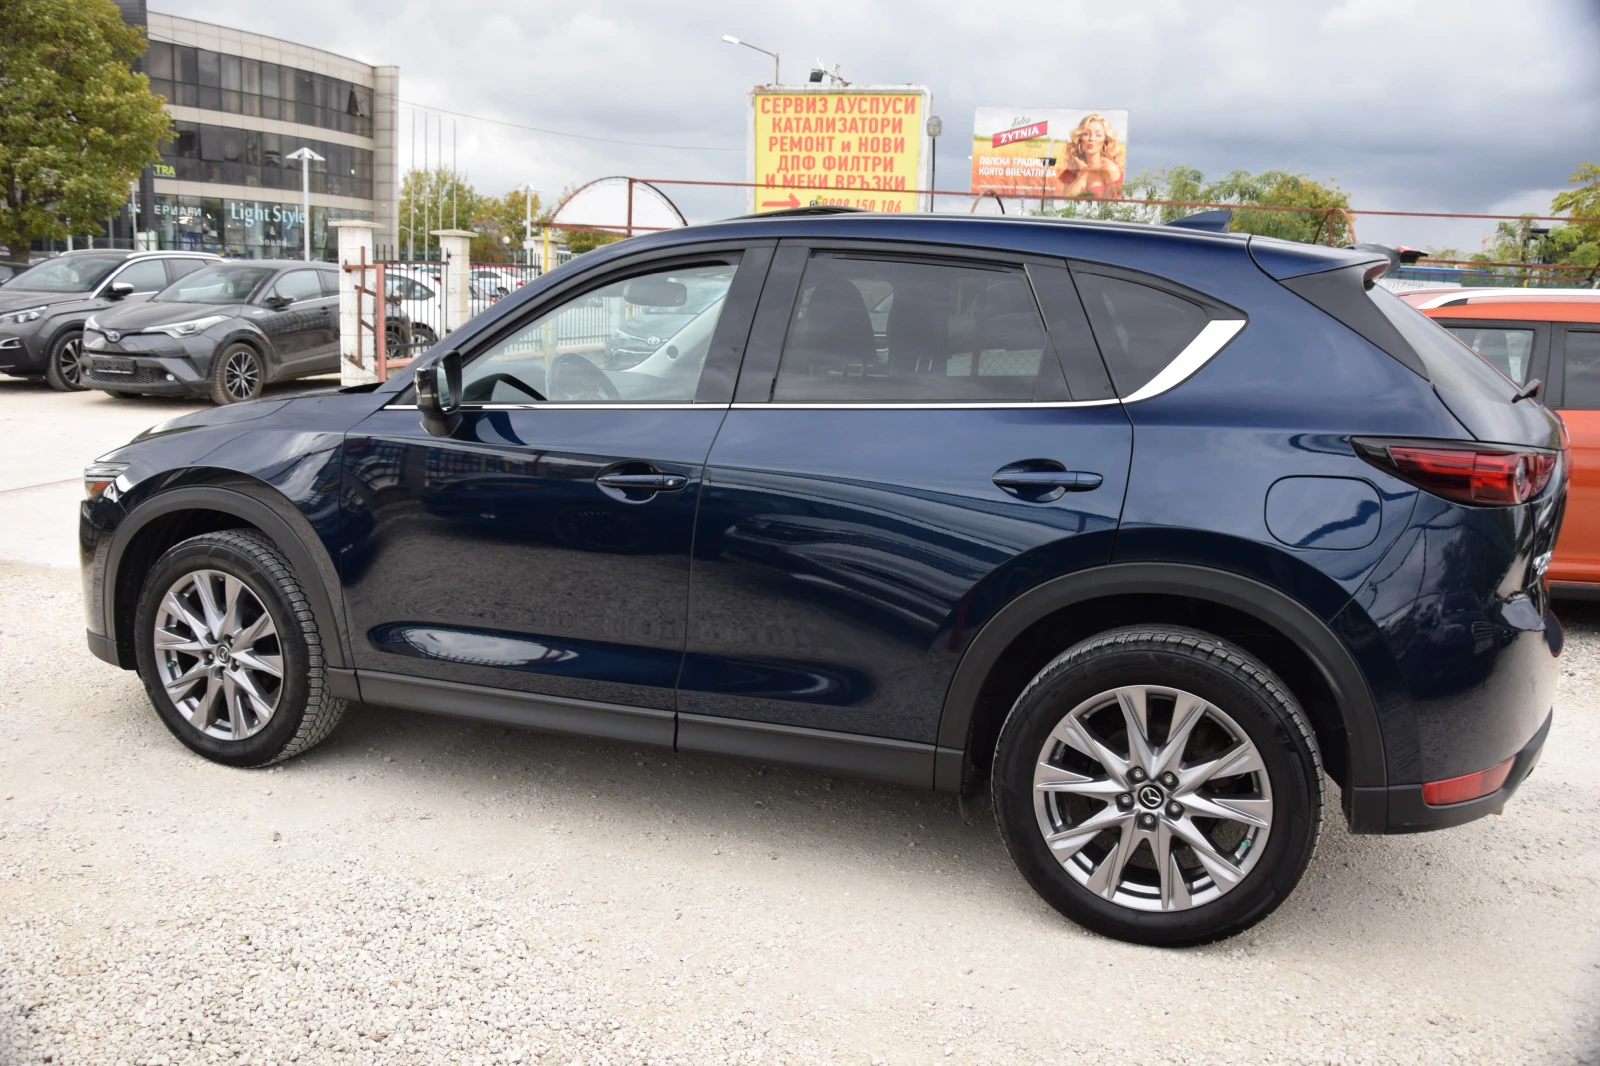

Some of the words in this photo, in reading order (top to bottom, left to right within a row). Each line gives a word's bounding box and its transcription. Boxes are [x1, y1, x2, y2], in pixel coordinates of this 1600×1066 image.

[761, 97, 828, 115] СЕРВИЗ
[835, 97, 916, 115] АУСПУСИ
[772, 117, 903, 134] КАТАЛИЗАТОРИ
[768, 136, 836, 152] РЕМОНТ
[841, 140, 851, 152] и
[858, 137, 905, 153] НОВИ
[776, 155, 816, 173] ДПФ
[822, 155, 894, 172] ФИЛТРИ
[979, 156, 1010, 165] ПОЛСКА
[153, 164, 176, 175] TRA
[978, 167, 1004, 176] КОЯТО
[765, 173, 776, 189] И
[782, 174, 829, 190] МЕКИ
[835, 174, 906, 191] ВРЪЗКИ
[880, 199, 902, 213] 106
[231, 201, 271, 228] Light
[272, 205, 306, 229] Style
[259, 237, 287, 247] Sound
